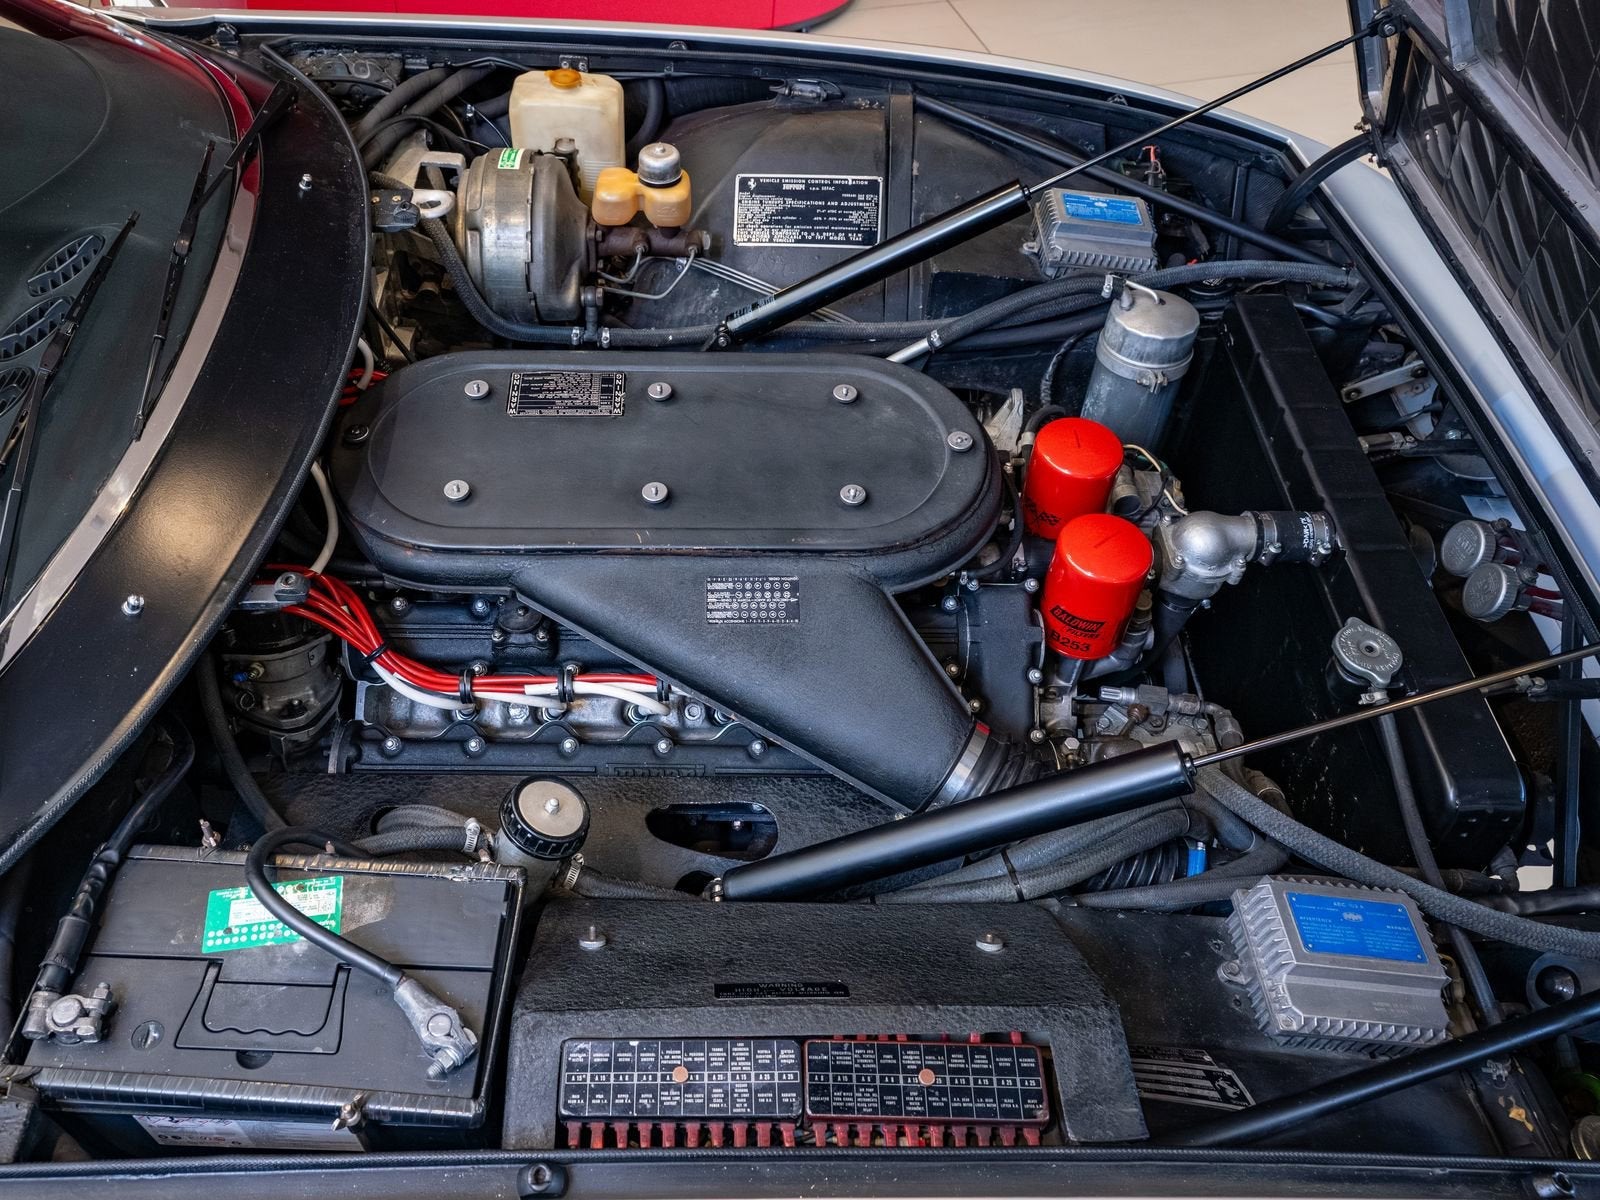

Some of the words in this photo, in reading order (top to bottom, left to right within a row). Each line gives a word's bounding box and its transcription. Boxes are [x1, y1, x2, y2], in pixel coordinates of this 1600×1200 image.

[510, 374, 520, 414] WARNING
[1054, 608, 1101, 631] BALDWIN
[1051, 630, 1090, 651] B253
